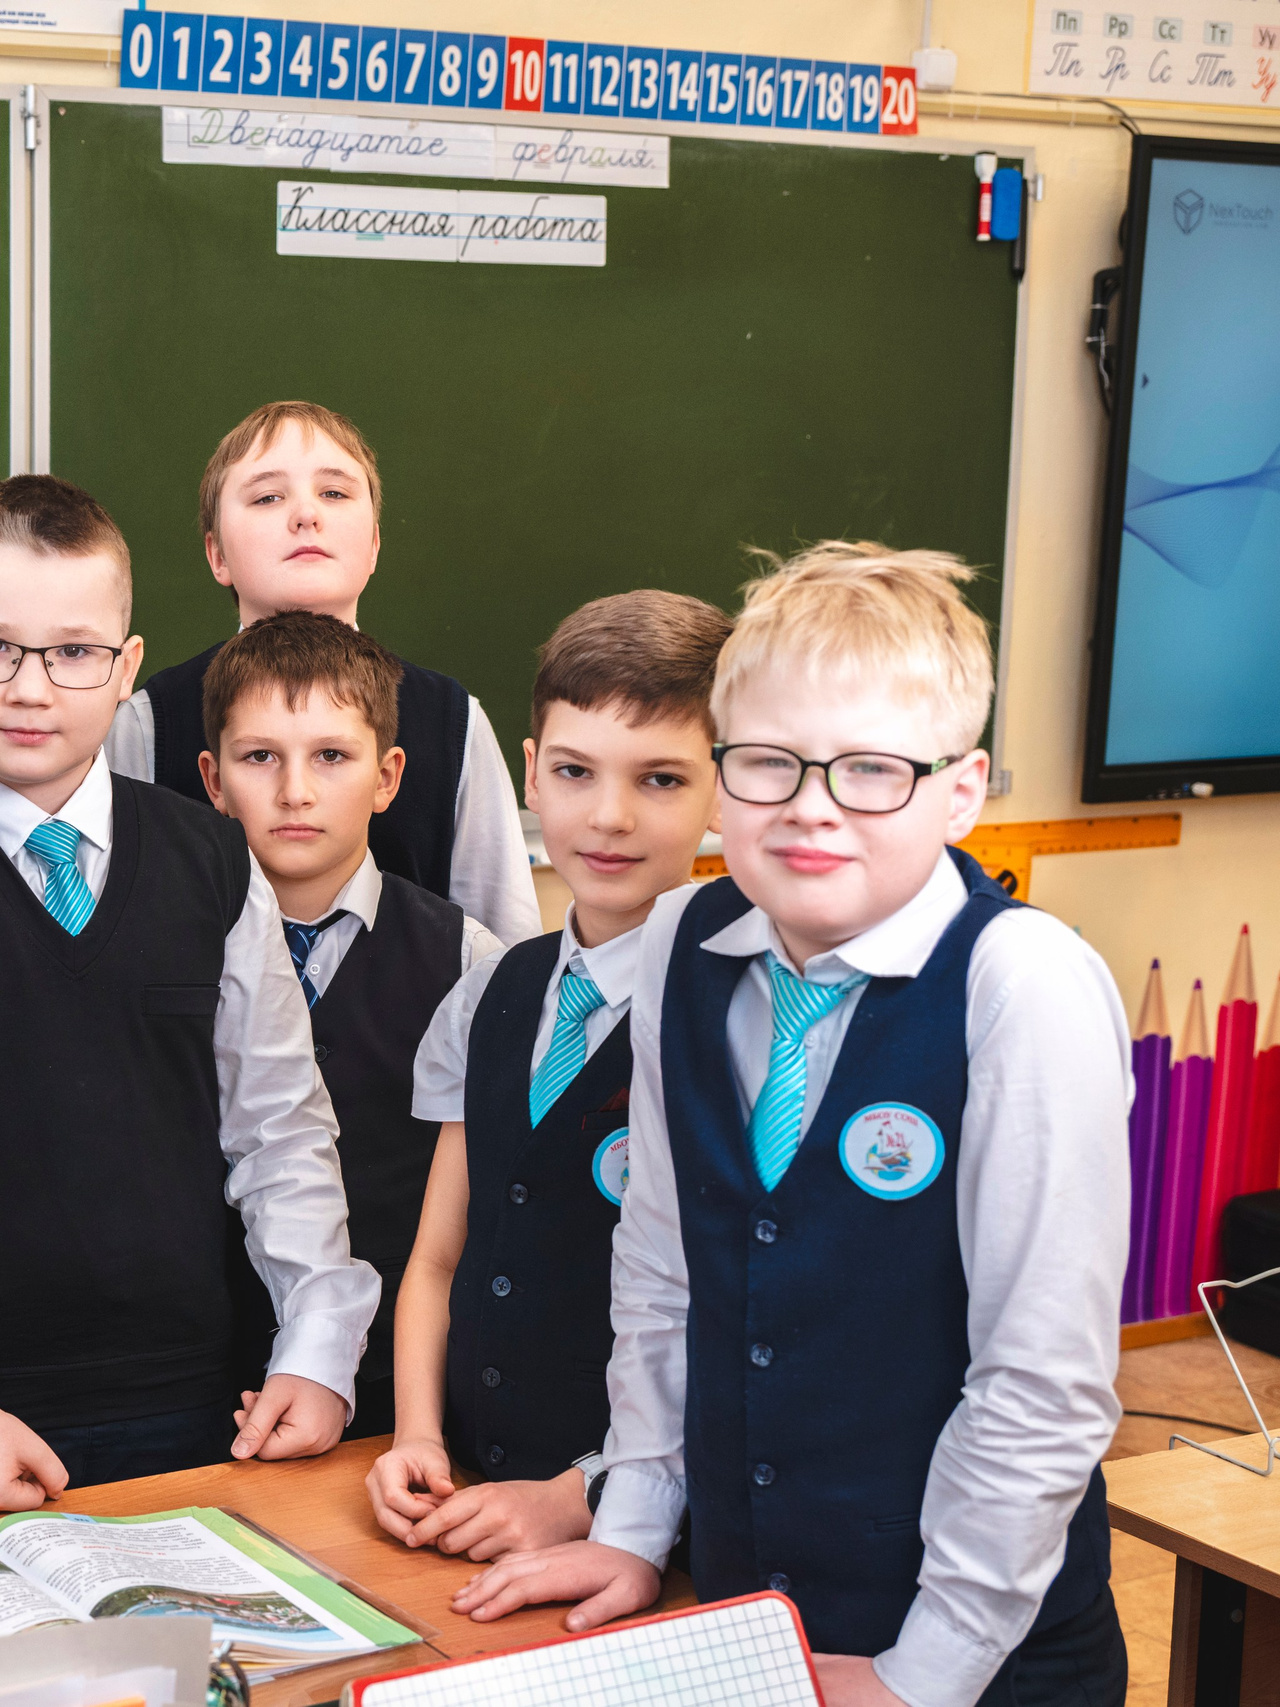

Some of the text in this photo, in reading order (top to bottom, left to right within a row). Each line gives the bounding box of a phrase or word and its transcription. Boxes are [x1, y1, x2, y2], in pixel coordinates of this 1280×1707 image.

[129, 23, 916, 126] 0 1 2 3 4 5 6 7 8 9 10 11 12 13 14 15 16 17 18 19 20
[281, 186, 604, 257] Классная работа
